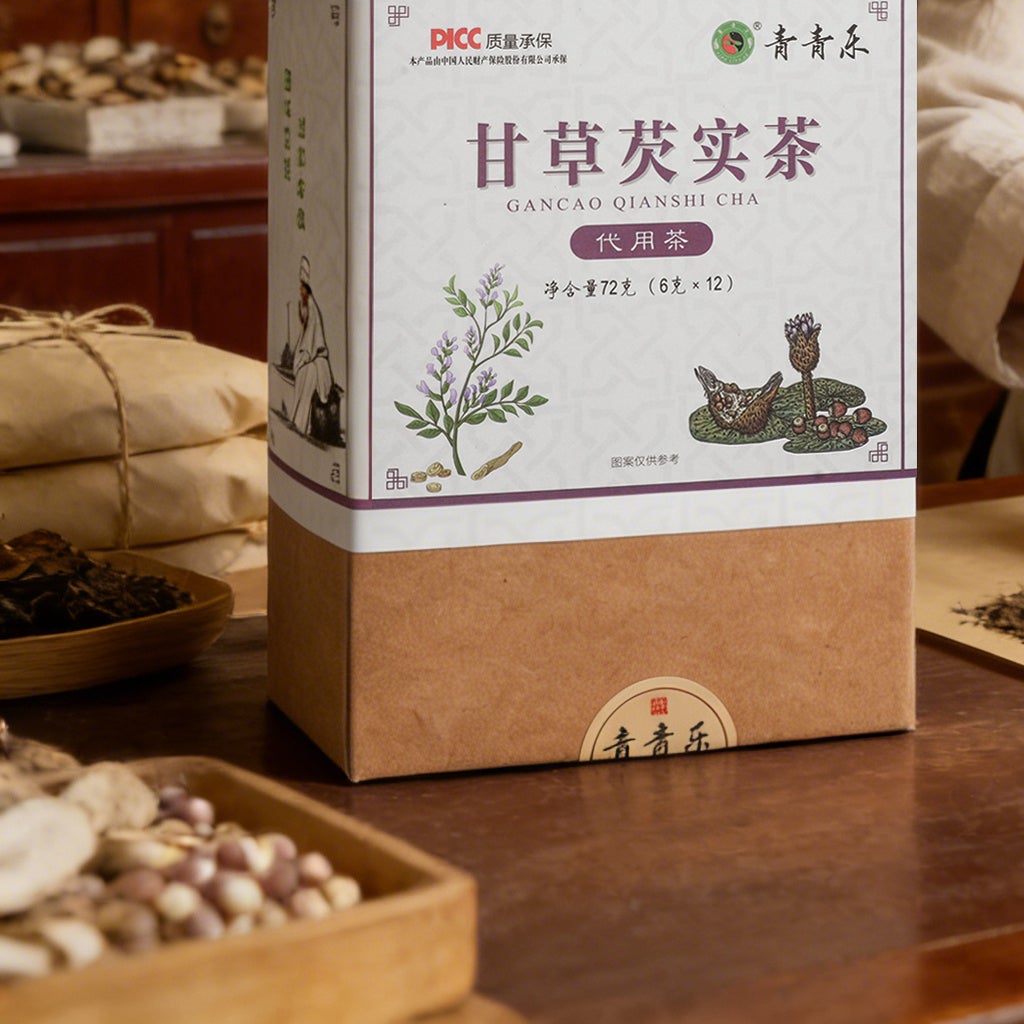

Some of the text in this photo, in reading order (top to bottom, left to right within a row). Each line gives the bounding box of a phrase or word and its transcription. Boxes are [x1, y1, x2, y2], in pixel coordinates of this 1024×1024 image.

[430, 27, 553, 50] PICC 质量承保
[764, 23, 870, 61] 青青乐
[466, 116, 822, 189] 甘草芡实茶
[506, 192, 760, 213] GANCAO QIANSHI CHA
[596, 229, 689, 253] 代用茶
[611, 453, 680, 468] 图案仅供参考
